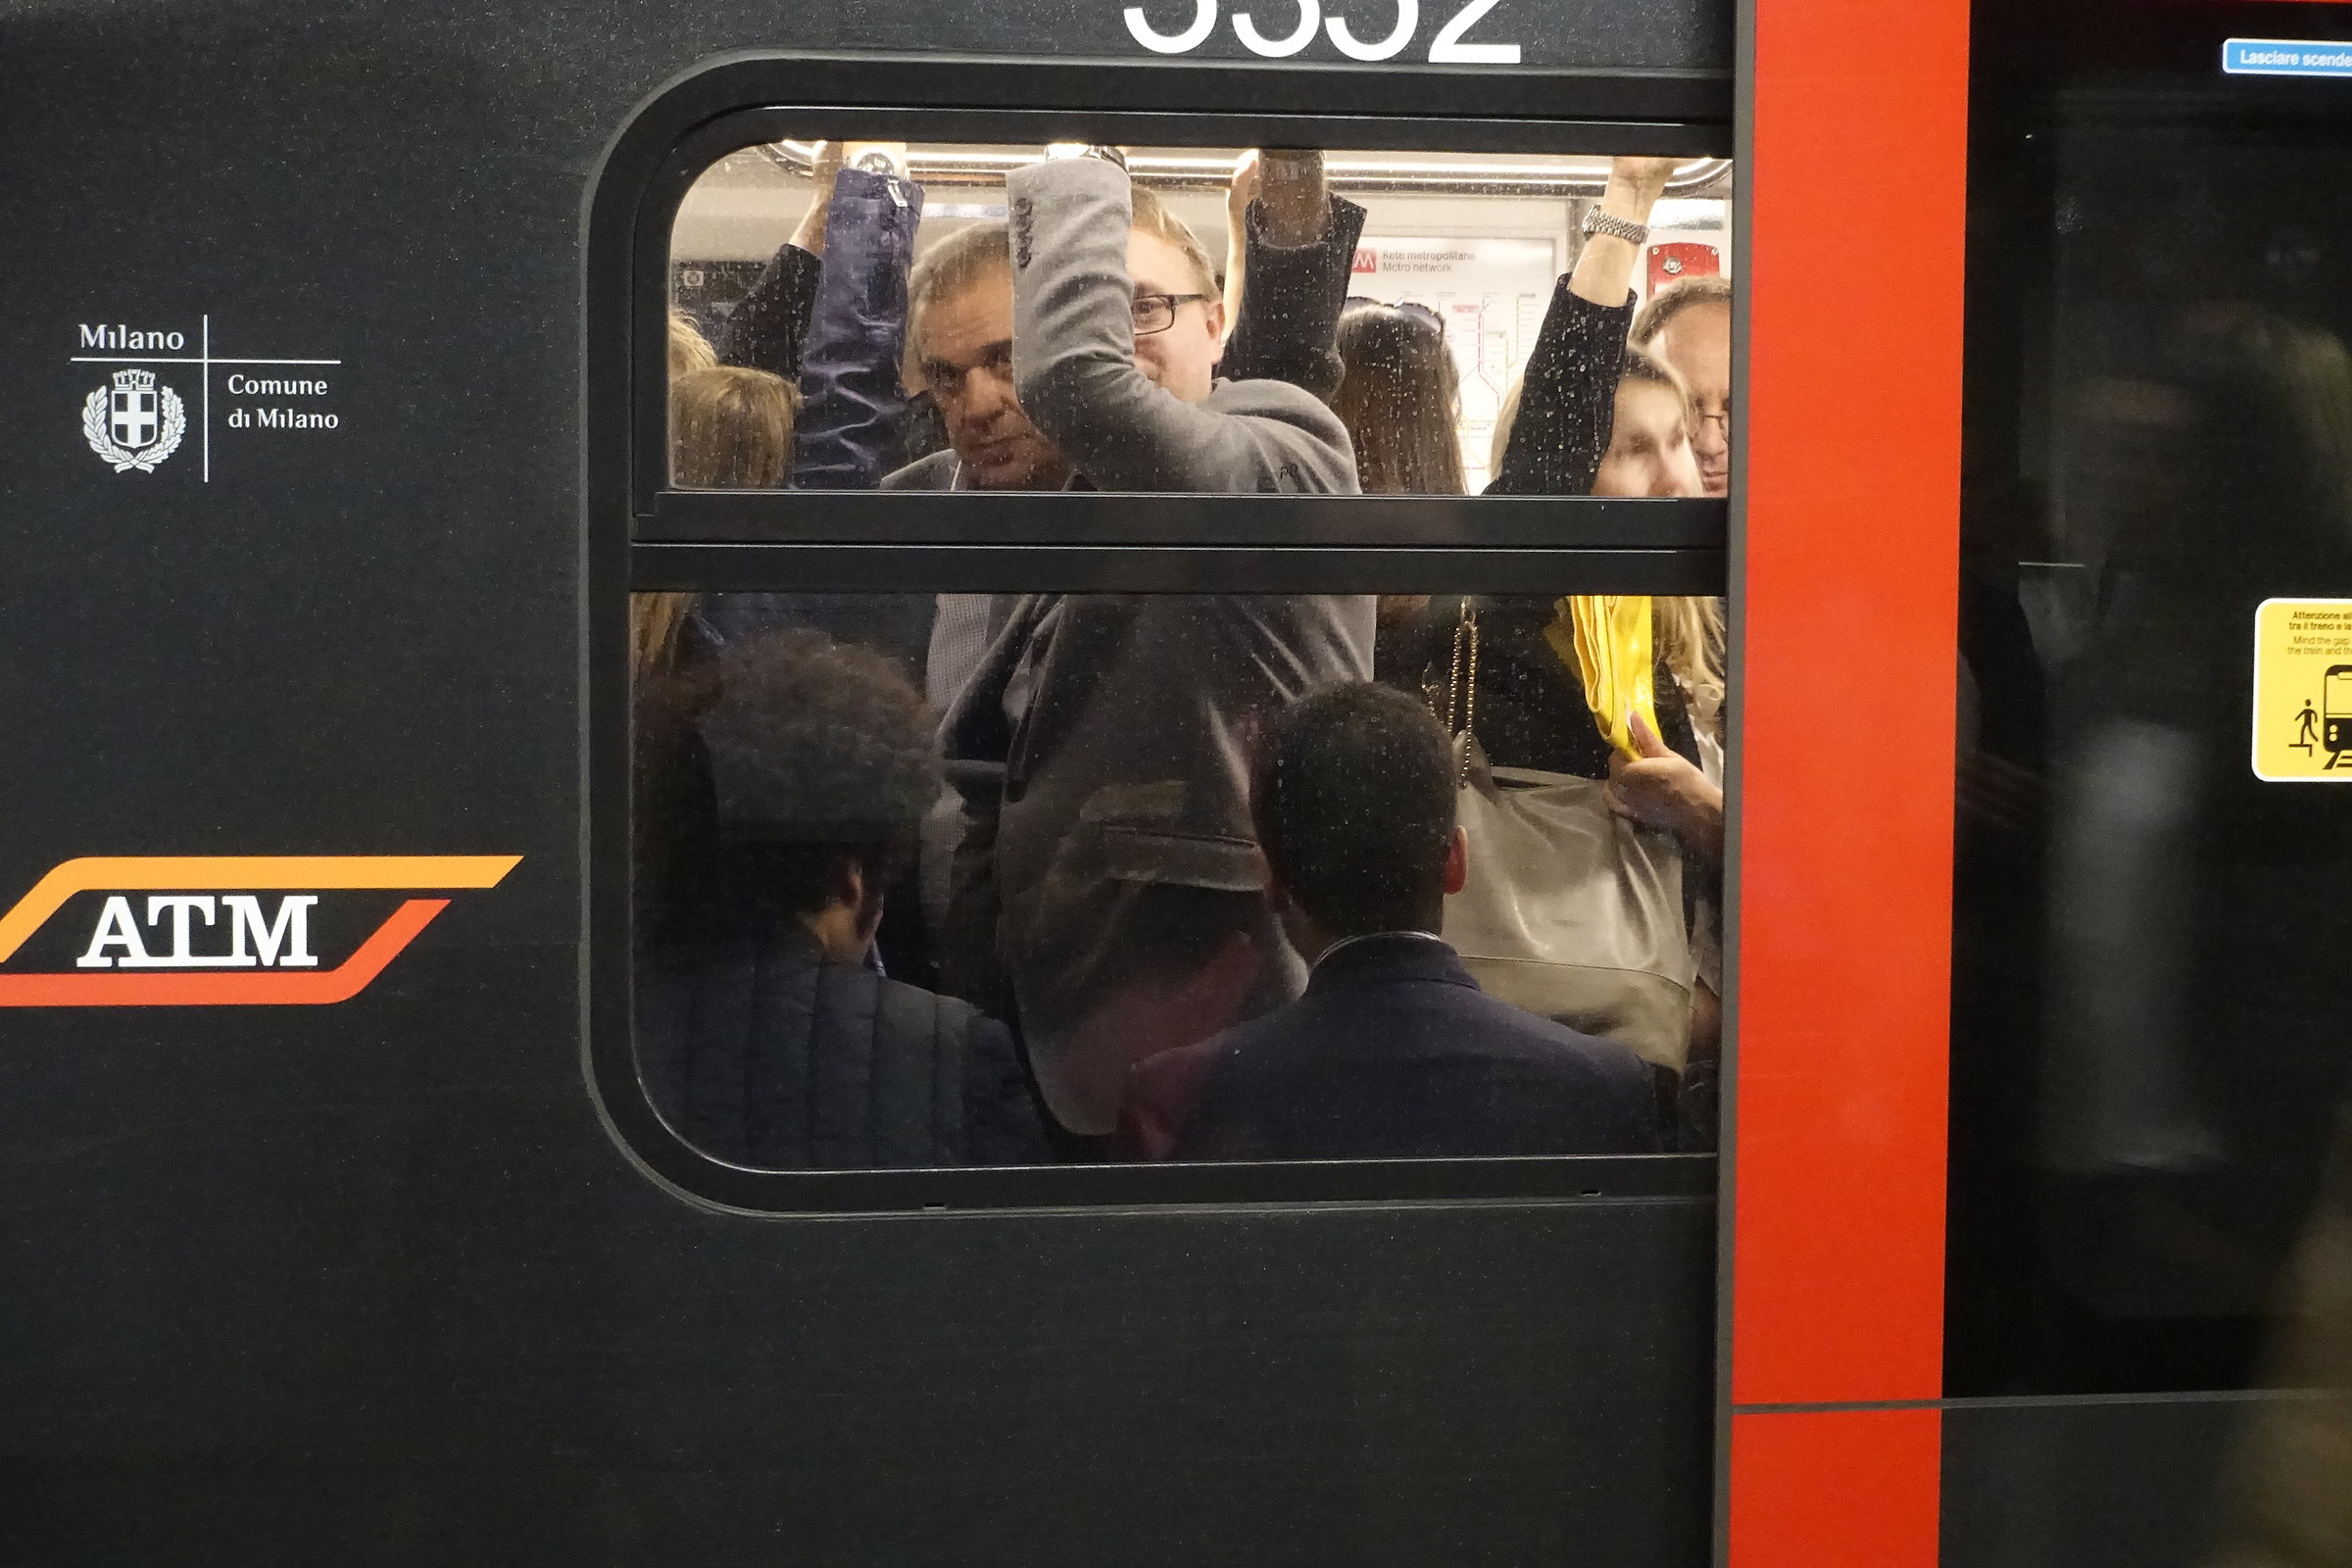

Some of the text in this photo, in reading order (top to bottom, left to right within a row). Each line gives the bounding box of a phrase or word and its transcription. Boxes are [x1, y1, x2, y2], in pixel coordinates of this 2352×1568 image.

[2240, 49, 2299, 66] Lasciare
[1407, 251, 1476, 262] metropolitana
[1383, 263, 1452, 272] Metro network
[78, 323, 184, 350] Milano
[227, 374, 328, 395] Comune
[227, 409, 339, 428] di Milano
[2288, 621, 2301, 630] tra
[2303, 621, 2308, 630] il
[2310, 621, 2334, 630] treno
[2293, 636, 2350, 647] Mind the gap
[76, 896, 318, 967] ATM
